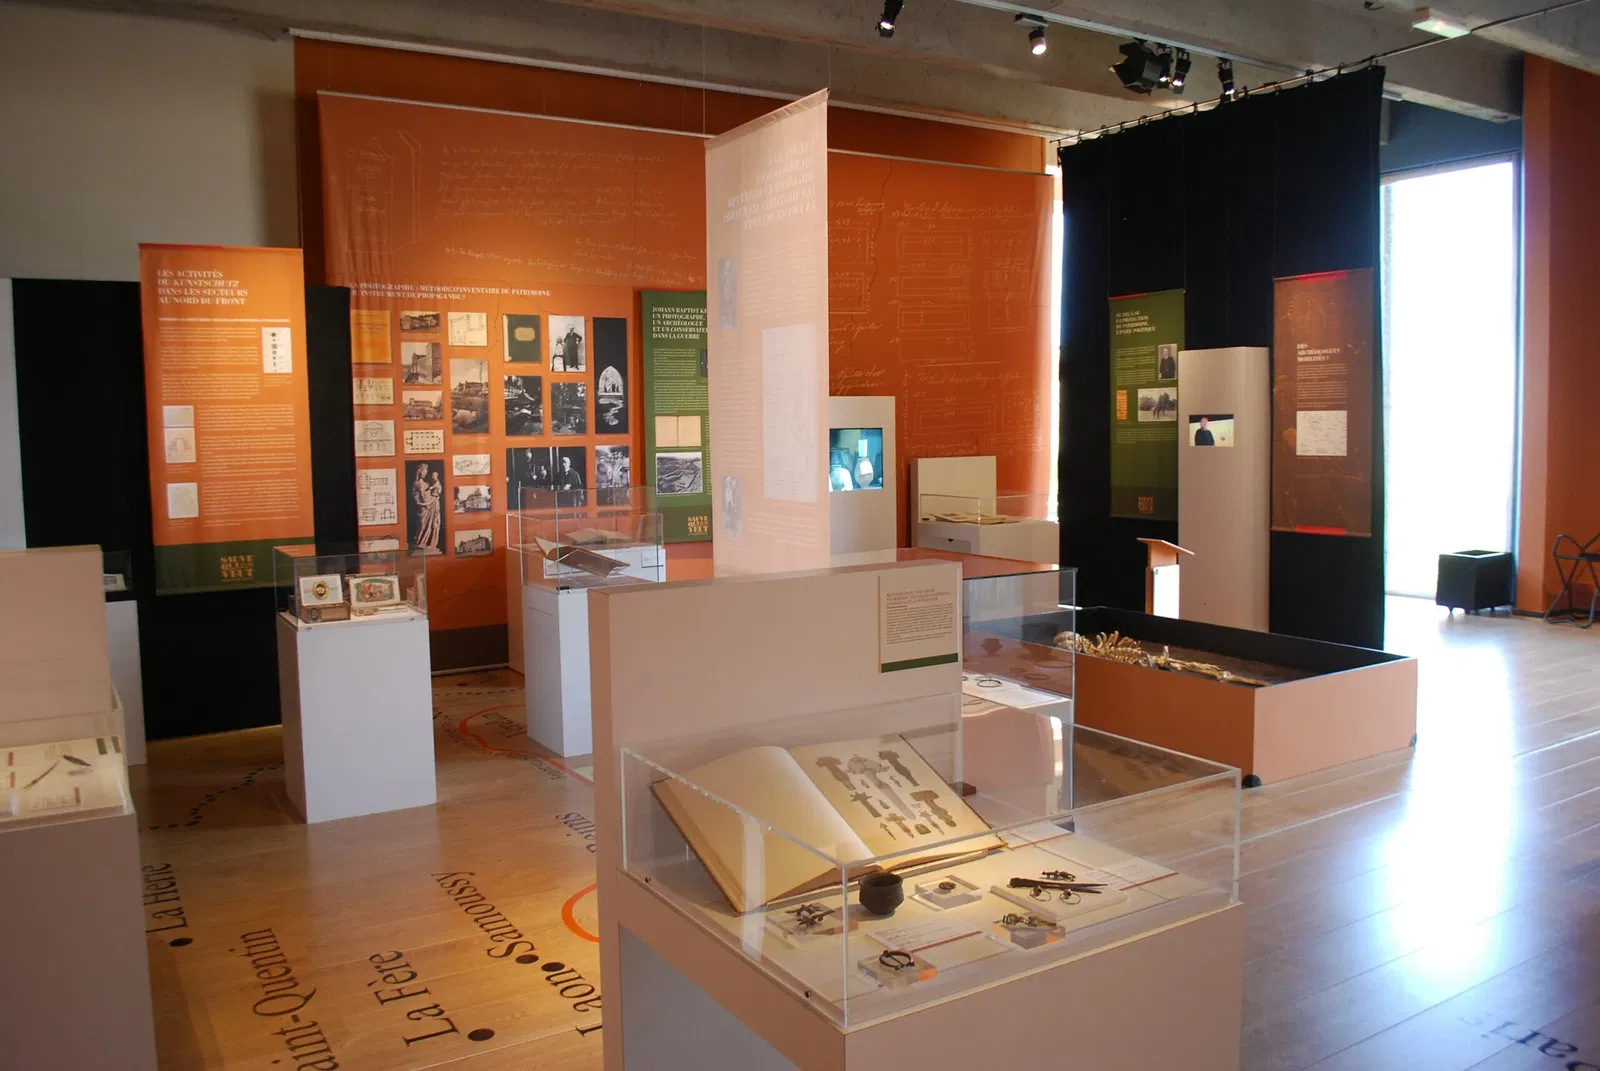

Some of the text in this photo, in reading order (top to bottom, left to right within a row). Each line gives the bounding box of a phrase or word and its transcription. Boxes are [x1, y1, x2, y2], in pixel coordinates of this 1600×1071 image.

[177, 269, 224, 278] ACTIVITÉS
[174, 279, 240, 287] KUNSTSCHUTZ
[202, 289, 248, 297] SECTEURS
[511, 288, 551, 296] PATRIMOINE
[215, 297, 246, 305] FRONT
[430, 871, 536, 959] Samoussy
[145, 907, 188, 936] La
[228, 927, 340, 1071] aint-Quentin
[367, 950, 461, 1048] La Fère
